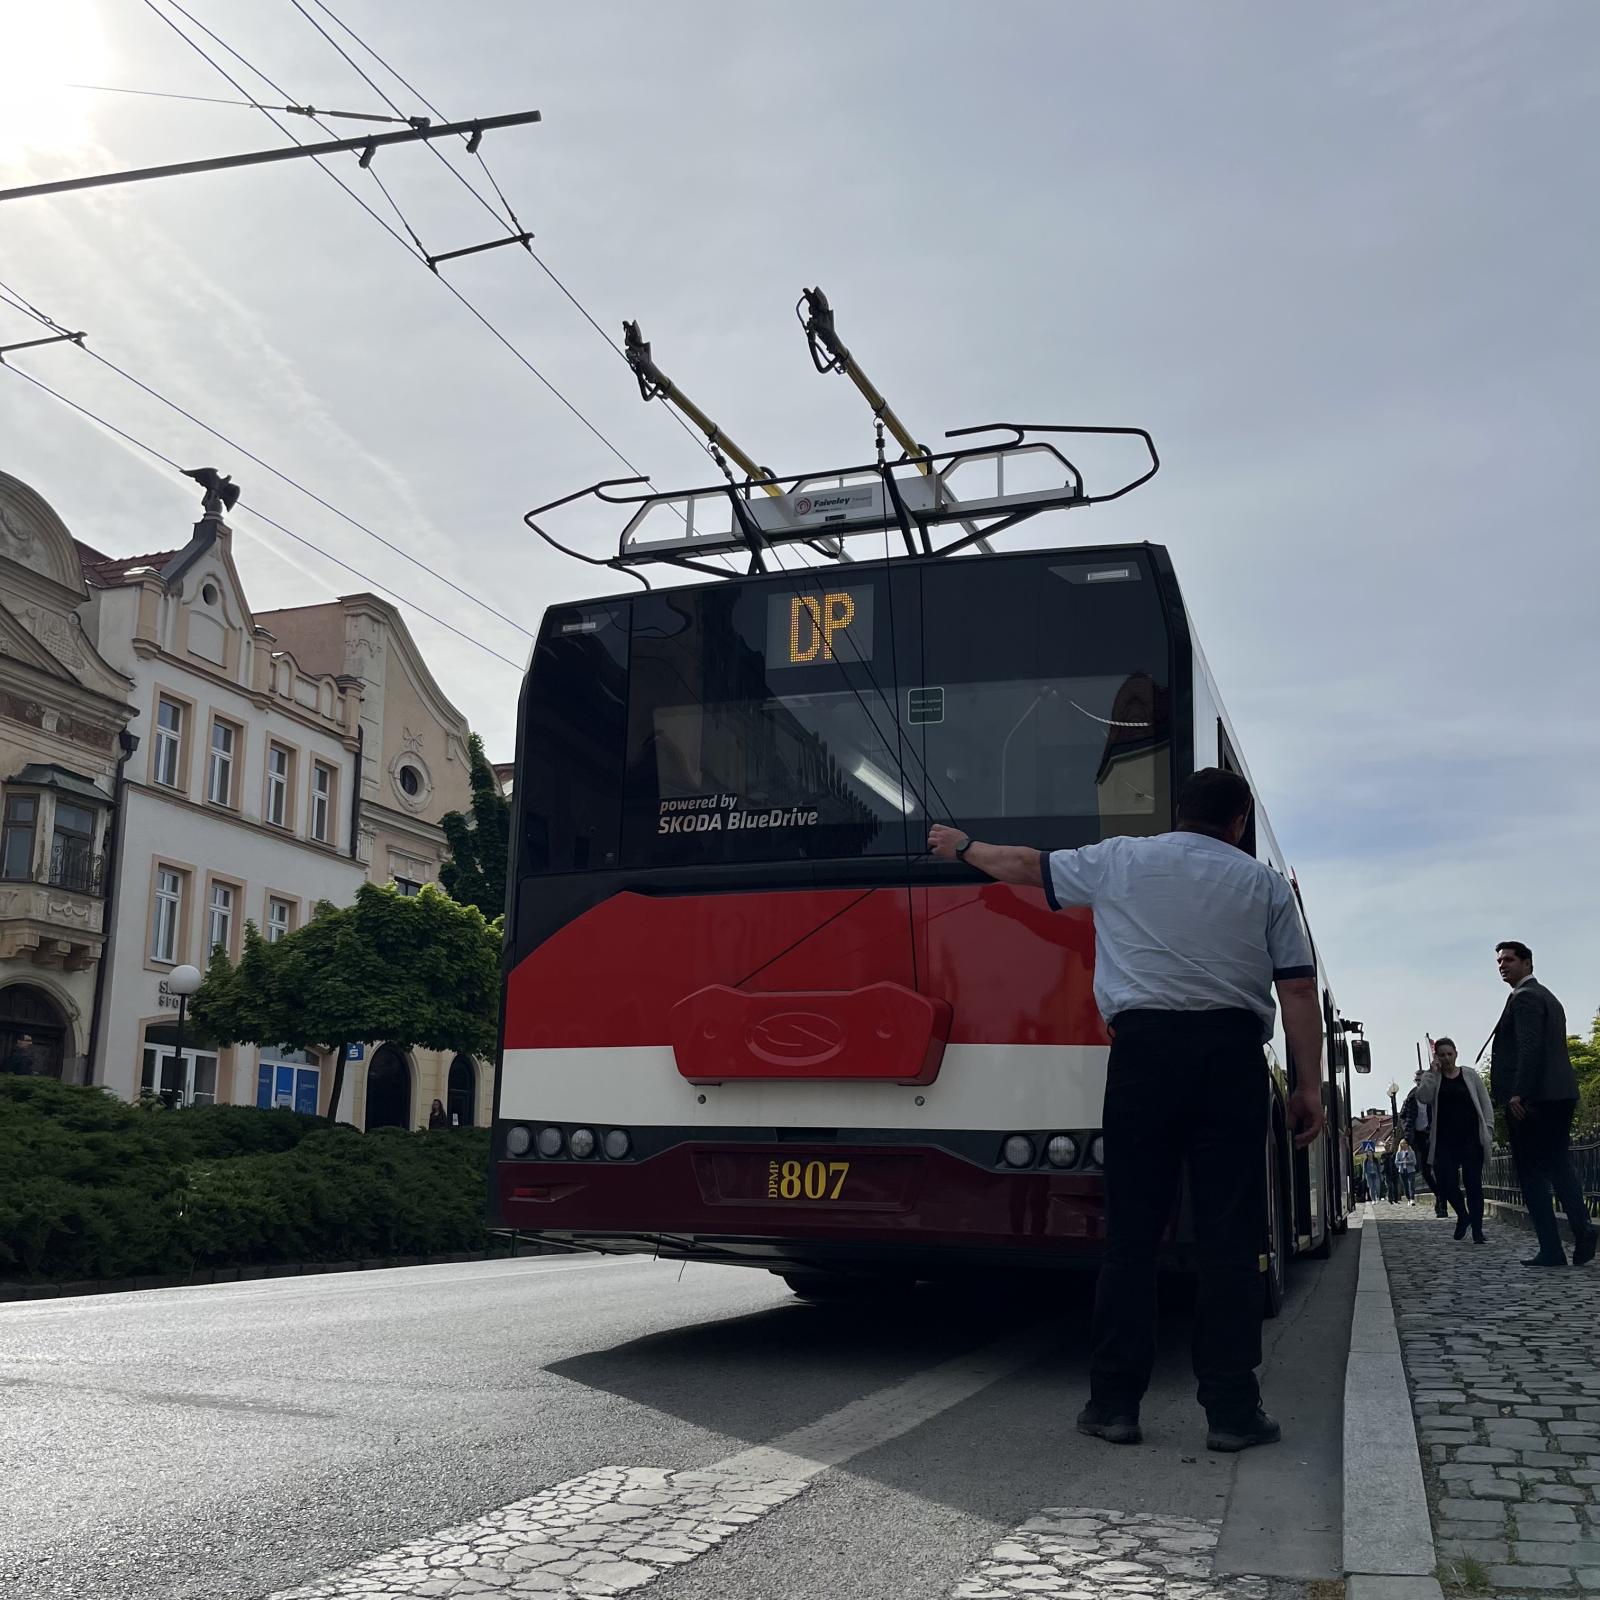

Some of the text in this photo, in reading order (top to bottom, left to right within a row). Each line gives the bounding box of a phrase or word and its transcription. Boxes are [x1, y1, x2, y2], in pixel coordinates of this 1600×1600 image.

[790, 592, 855, 663] DP
[657, 807, 819, 834] SKODA BlueDrive
[659, 794, 738, 815] powered by
[768, 1160, 779, 1199] DPMP
[780, 1160, 850, 1200] 807
